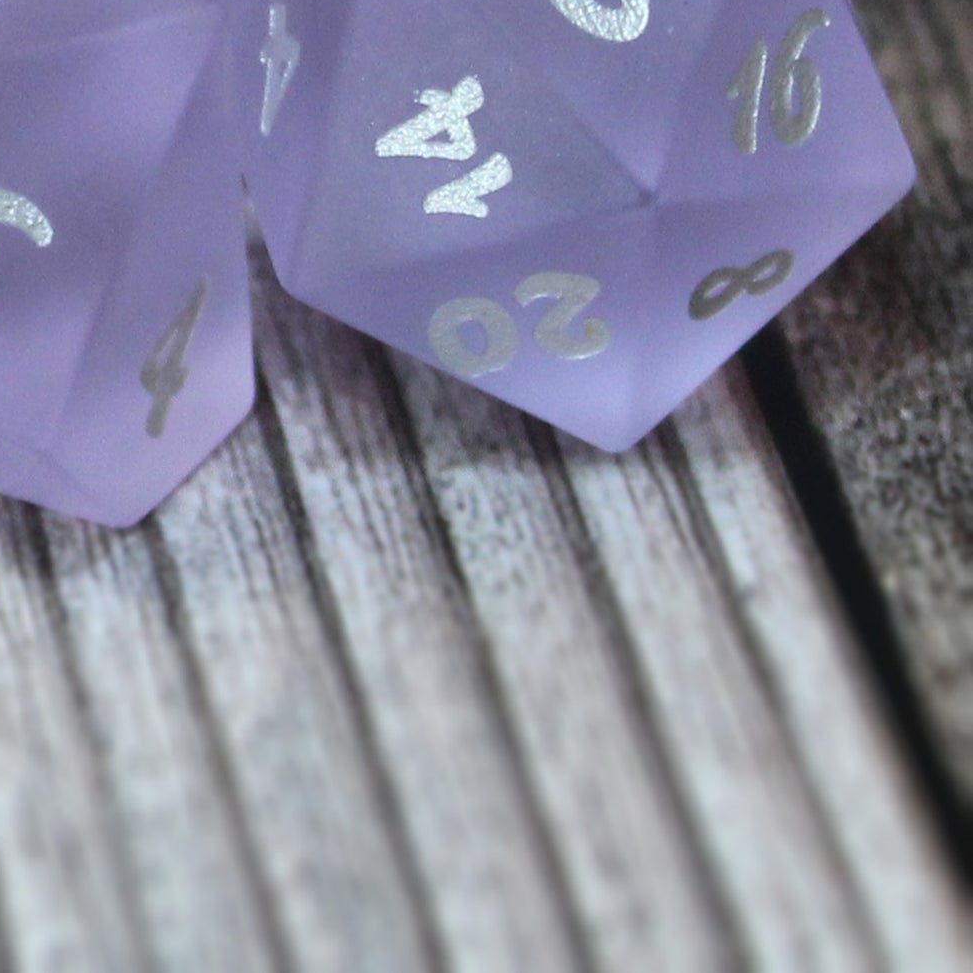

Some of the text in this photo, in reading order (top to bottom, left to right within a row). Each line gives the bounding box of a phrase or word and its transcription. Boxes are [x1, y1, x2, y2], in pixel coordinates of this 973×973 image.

[259, 3, 301, 137] 4
[728, 7, 829, 156] 16
[374, 74, 514, 218] 14
[426, 271, 612, 378] 20
[687, 248, 796, 321] 8
[140, 278, 209, 440] 4
